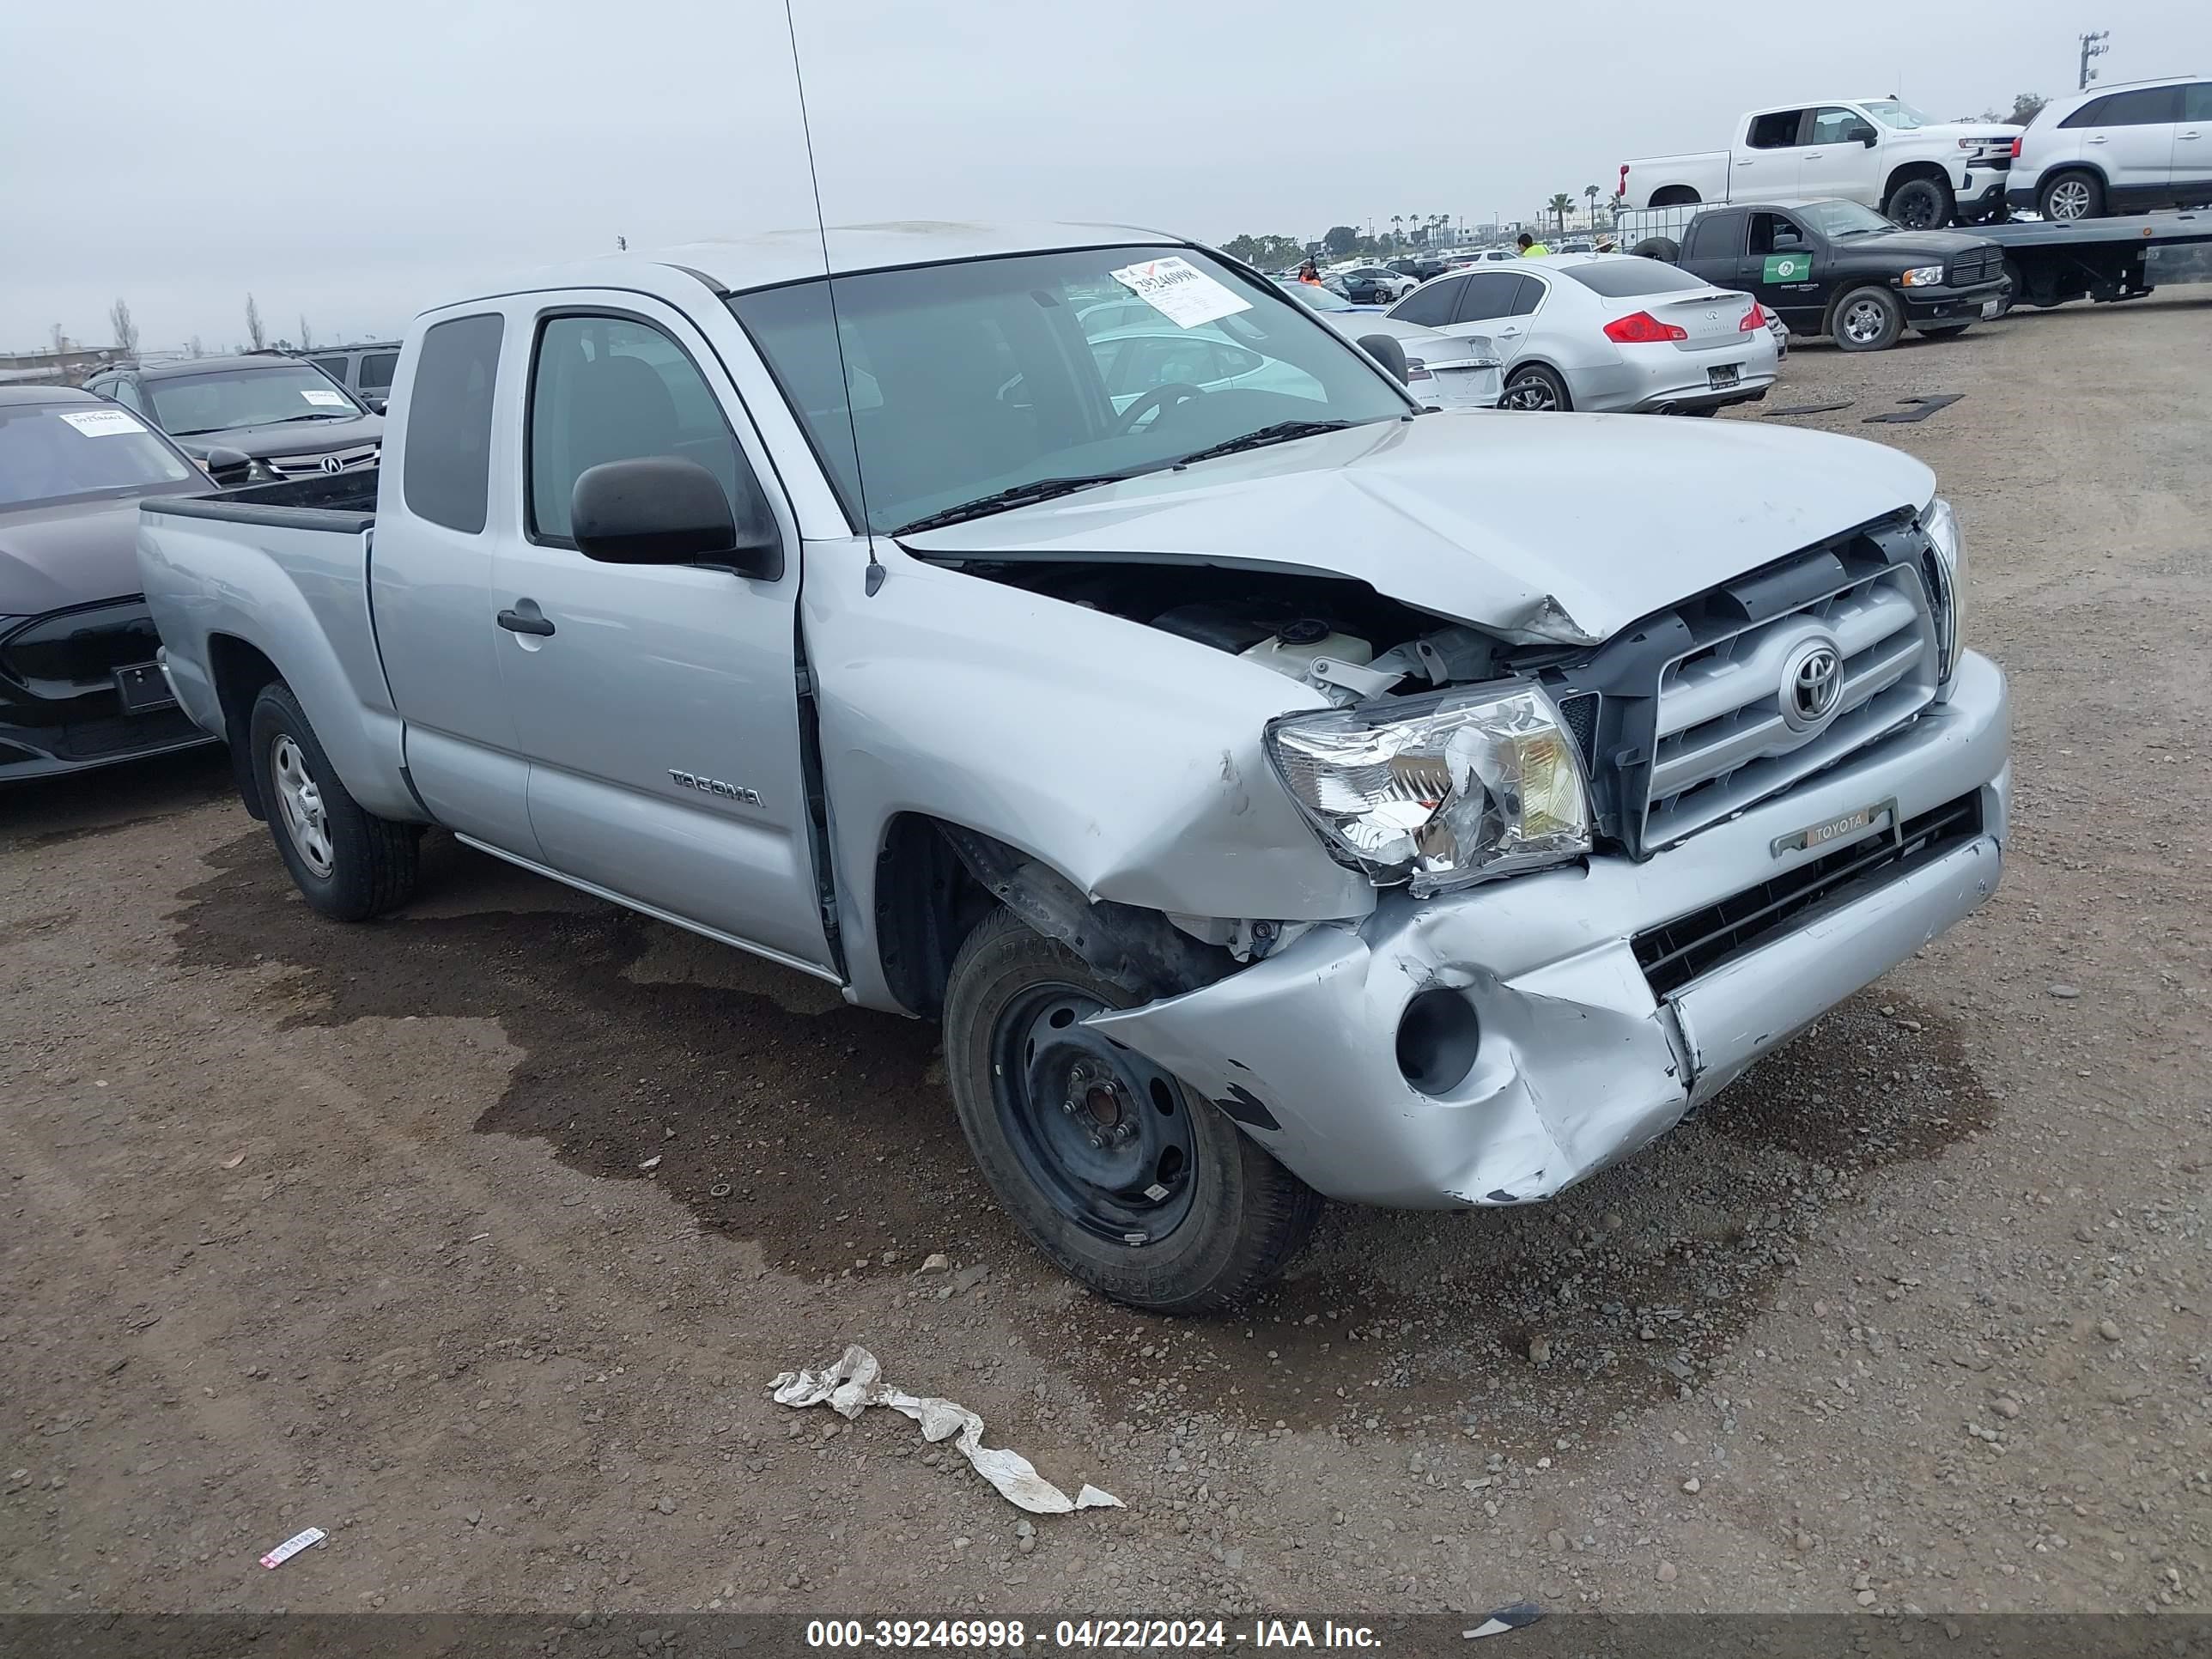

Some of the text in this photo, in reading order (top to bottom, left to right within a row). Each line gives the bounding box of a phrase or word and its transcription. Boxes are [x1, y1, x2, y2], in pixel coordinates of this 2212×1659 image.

[1135, 269, 1199, 292] 39246998
[667, 769, 766, 808] TACOMA
[1816, 814, 1863, 842] TOYOTA
